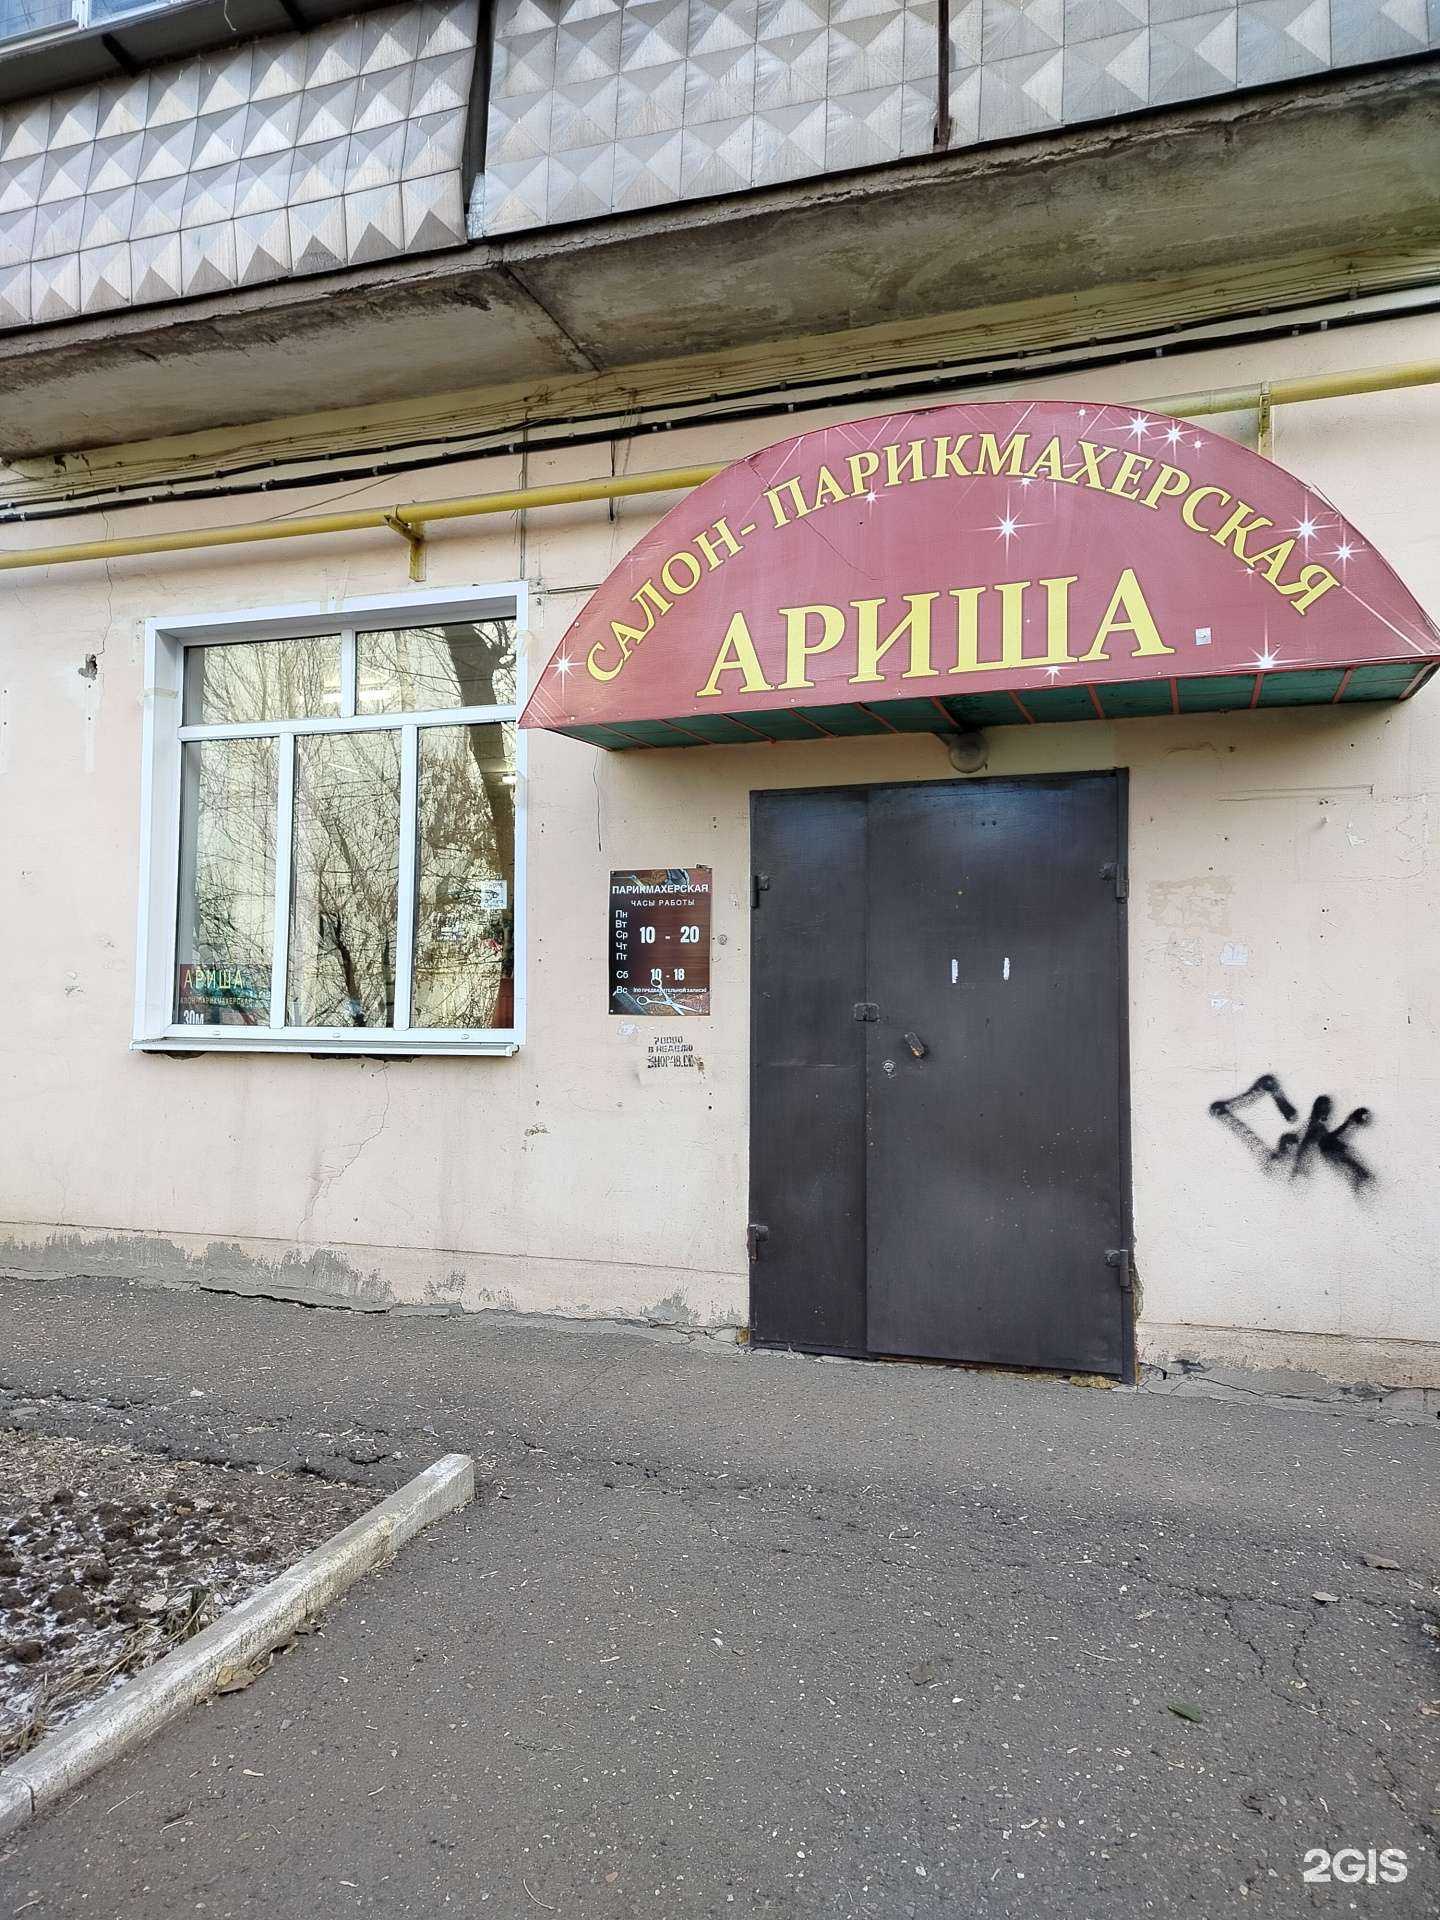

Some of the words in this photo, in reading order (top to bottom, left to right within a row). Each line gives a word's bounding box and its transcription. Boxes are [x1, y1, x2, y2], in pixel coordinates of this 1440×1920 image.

[696, 568, 1176, 697] АРИША
[612, 884, 709, 894] ПАРИКМАХЕРСКАЯ
[659, 899, 695, 907] РАБОТЫ
[615, 909, 628, 918] Пн
[615, 919, 628, 928] Вт
[615, 930, 628, 940] Ср
[640, 926, 656, 944] 10
[680, 926, 700, 943] 20
[615, 941, 628, 950] Чт
[615, 952, 628, 960] Пт
[184, 969, 243, 989] АРИША
[616, 970, 629, 979] Сб
[650, 968, 662, 981] 10
[673, 968, 685, 981] 18
[615, 985, 628, 994] Вс
